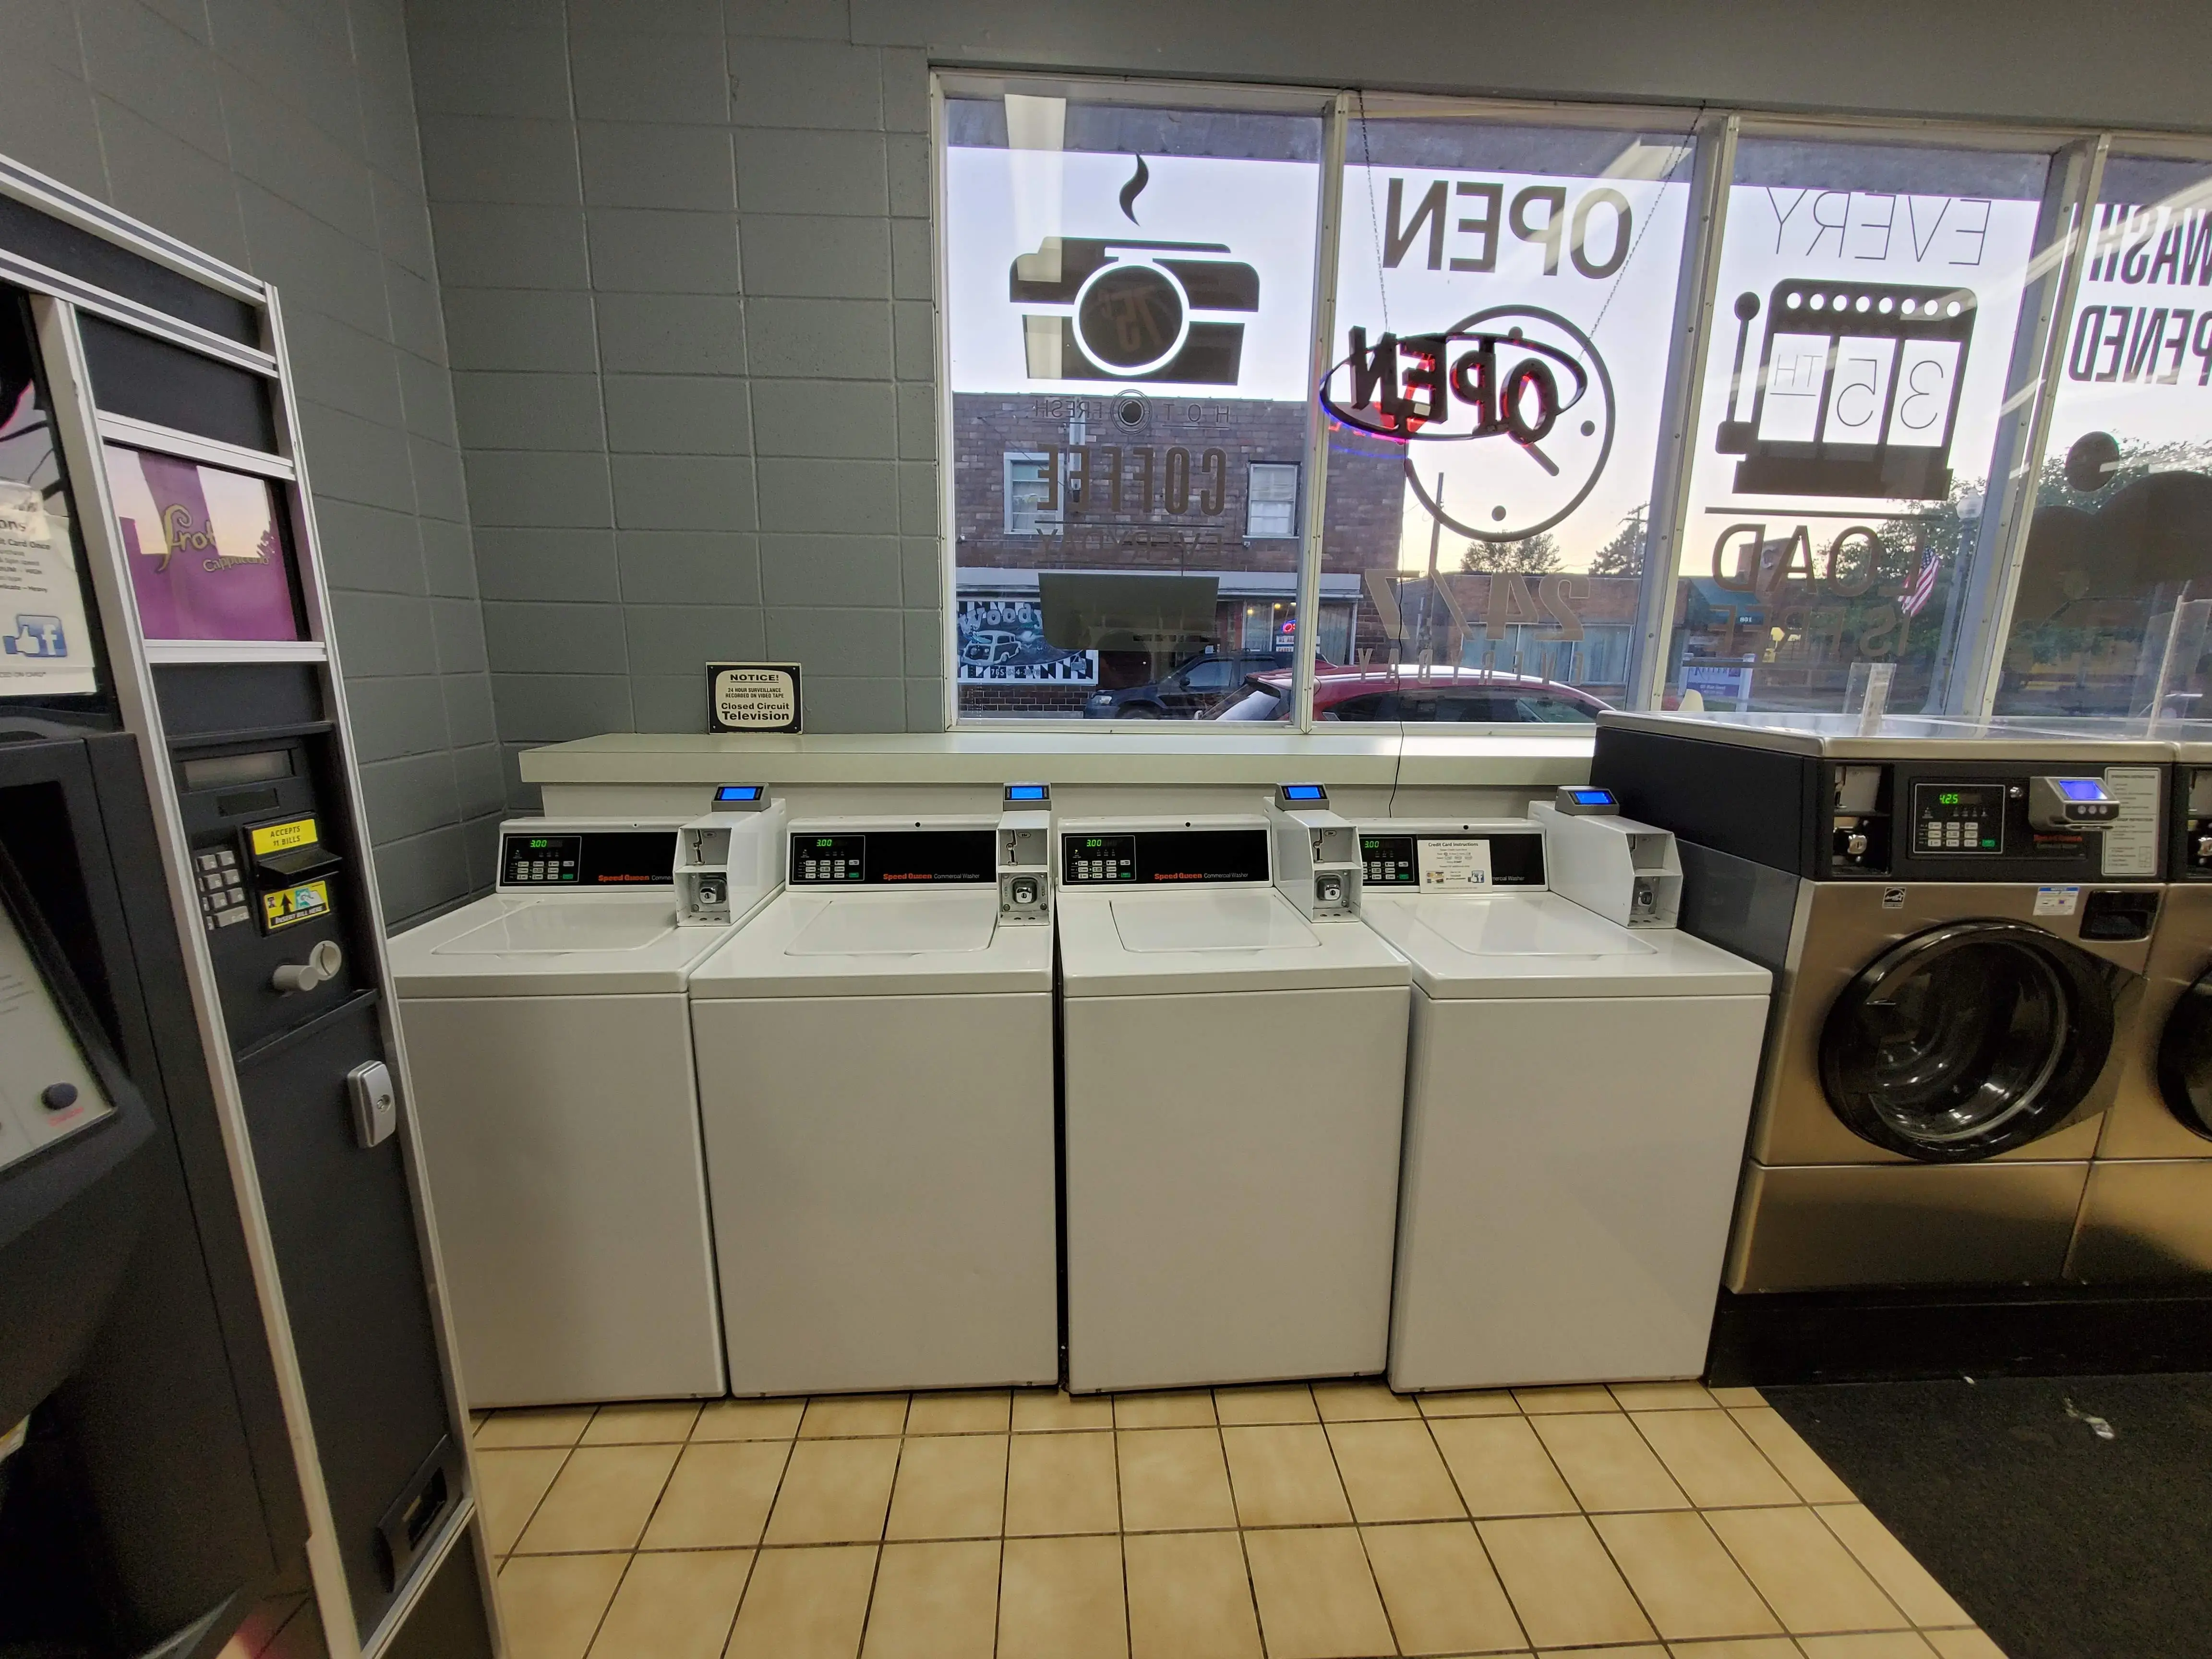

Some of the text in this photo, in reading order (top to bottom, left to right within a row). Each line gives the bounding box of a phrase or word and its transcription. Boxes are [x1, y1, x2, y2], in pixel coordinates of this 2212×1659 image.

[722, 711, 790, 720] Television
[270, 826, 301, 838] ACCEPTS
[282, 835, 301, 845] BILLS
[275, 914, 296, 924] INSERT
